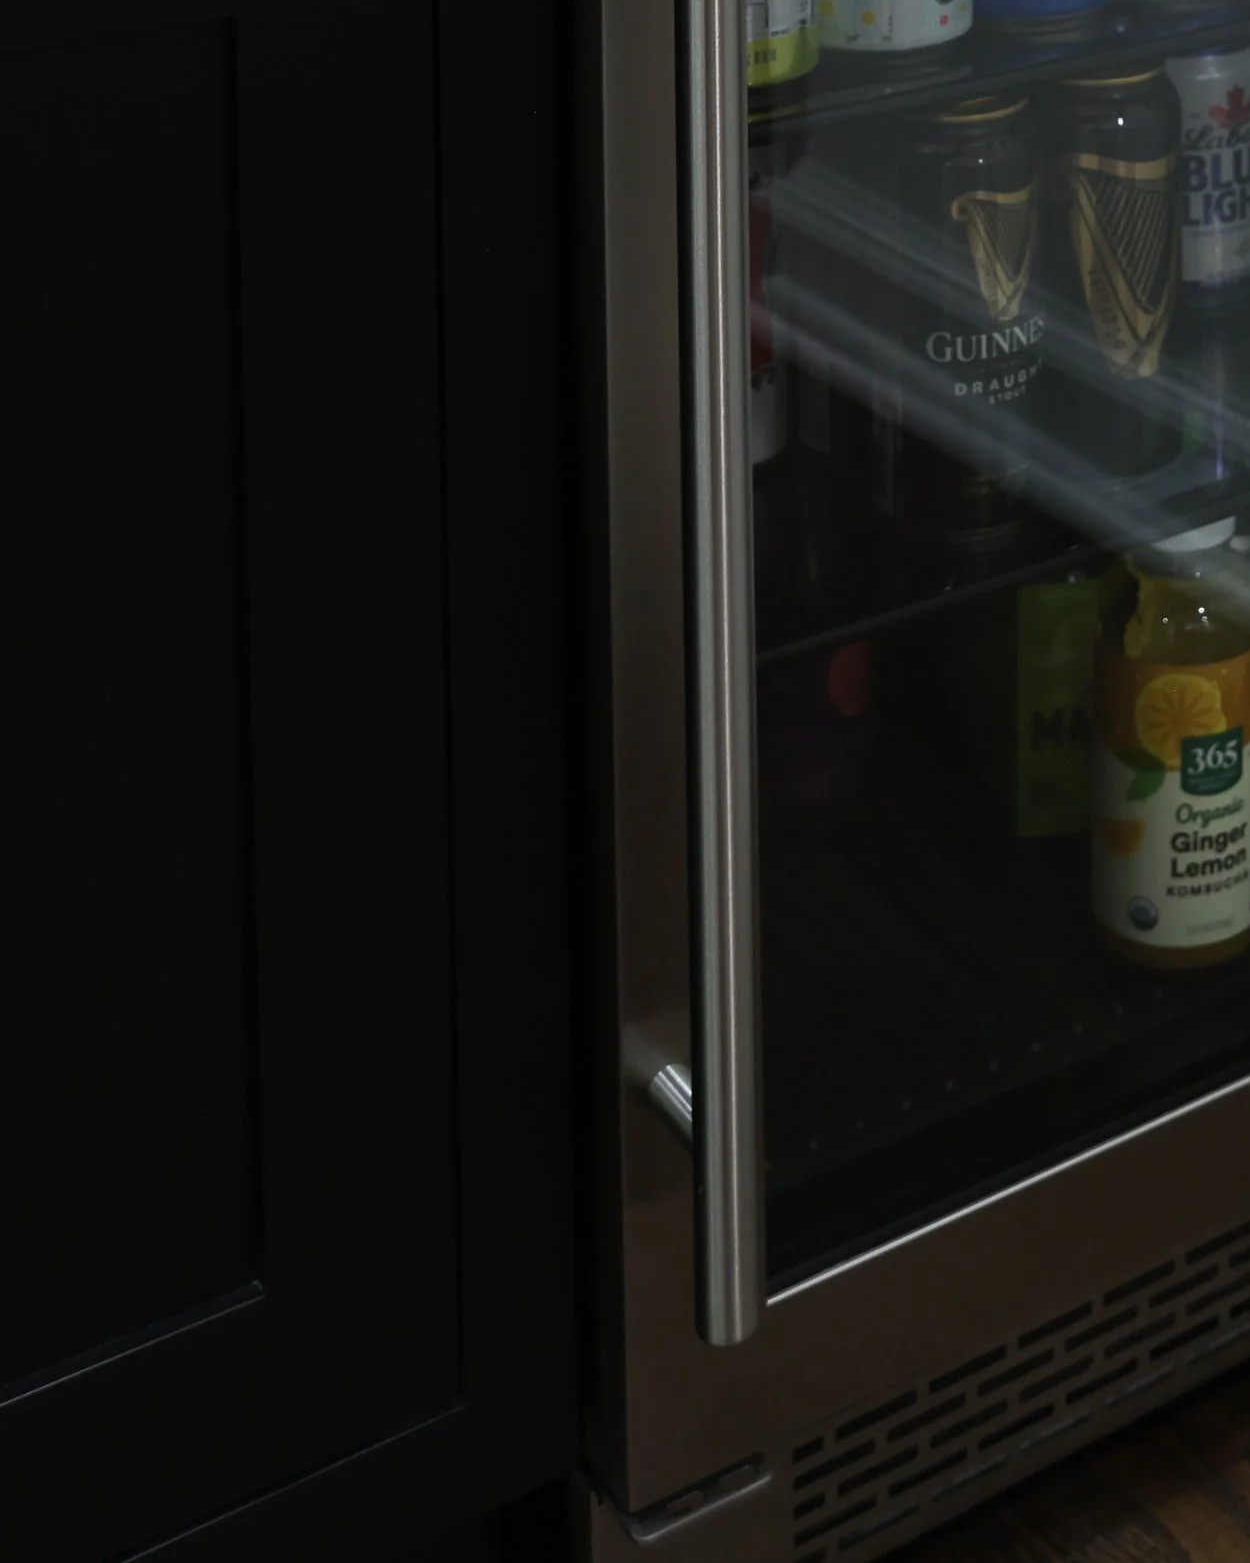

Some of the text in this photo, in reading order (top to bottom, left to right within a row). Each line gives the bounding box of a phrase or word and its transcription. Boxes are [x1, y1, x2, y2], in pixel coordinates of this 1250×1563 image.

[925, 315, 1044, 363] GUINNE
[1187, 739, 1238, 775] 365
[1170, 822, 1247, 853] Ginger
[1171, 849, 1246, 878] Lemon
